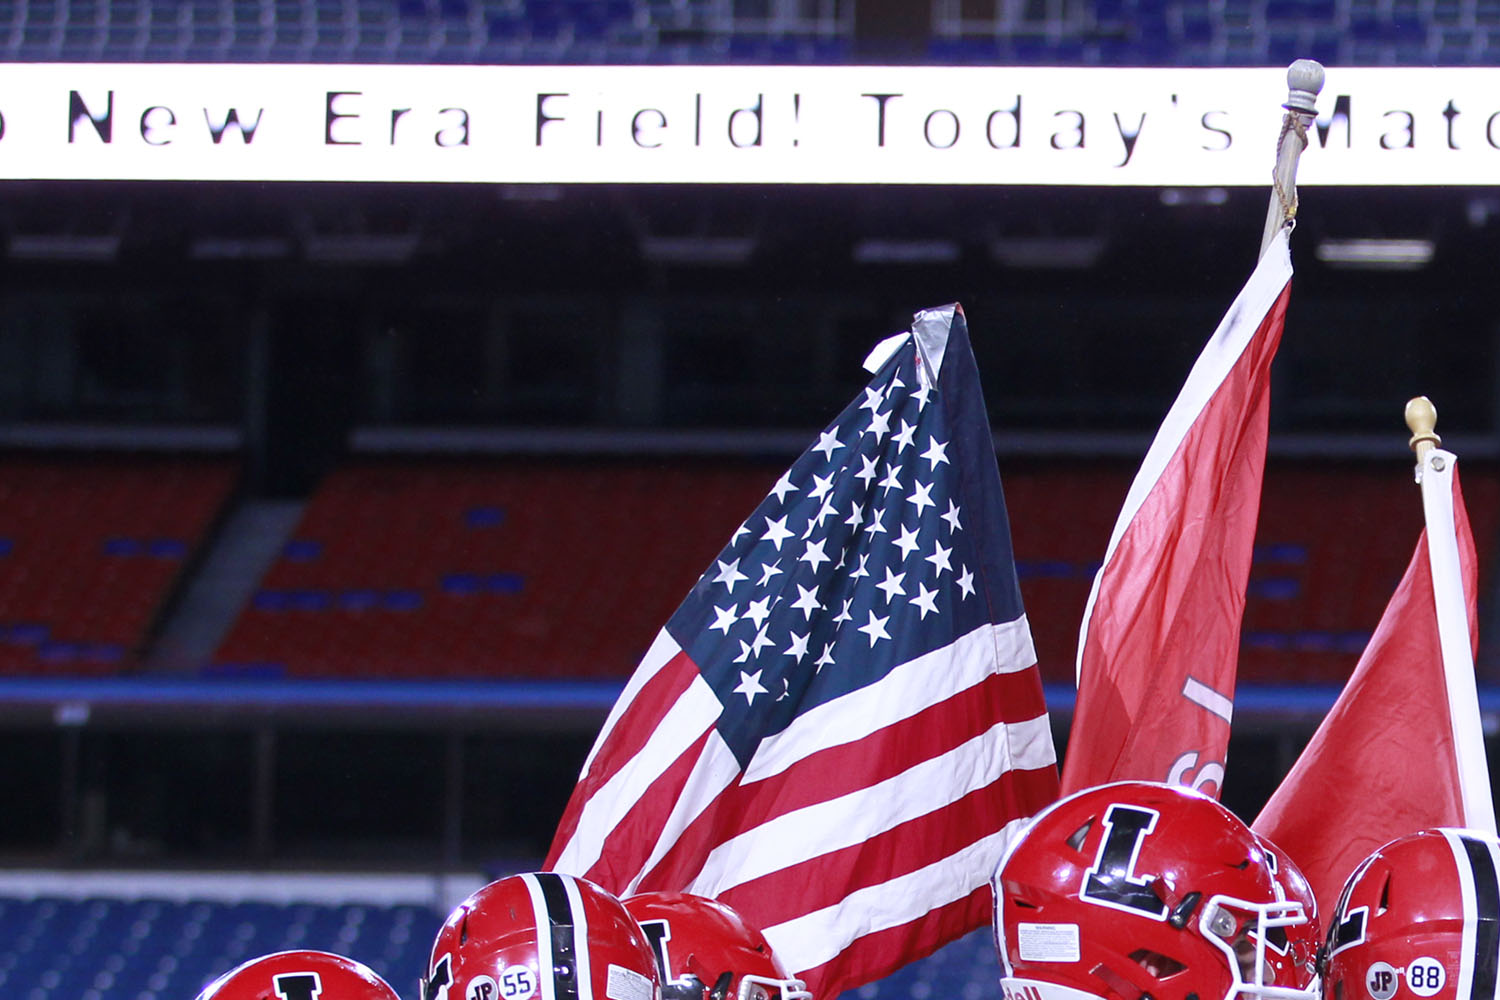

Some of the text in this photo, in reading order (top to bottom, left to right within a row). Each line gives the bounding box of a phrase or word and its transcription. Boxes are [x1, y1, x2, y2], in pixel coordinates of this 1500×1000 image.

[68, 90, 264, 146] New
[324, 91, 471, 147] Era
[535, 92, 801, 148] Field!
[860, 93, 1233, 168] Today's
[1079, 803, 1175, 921] L
[503, 971, 531, 997] 55
[1370, 965, 1440, 992] JP 88
